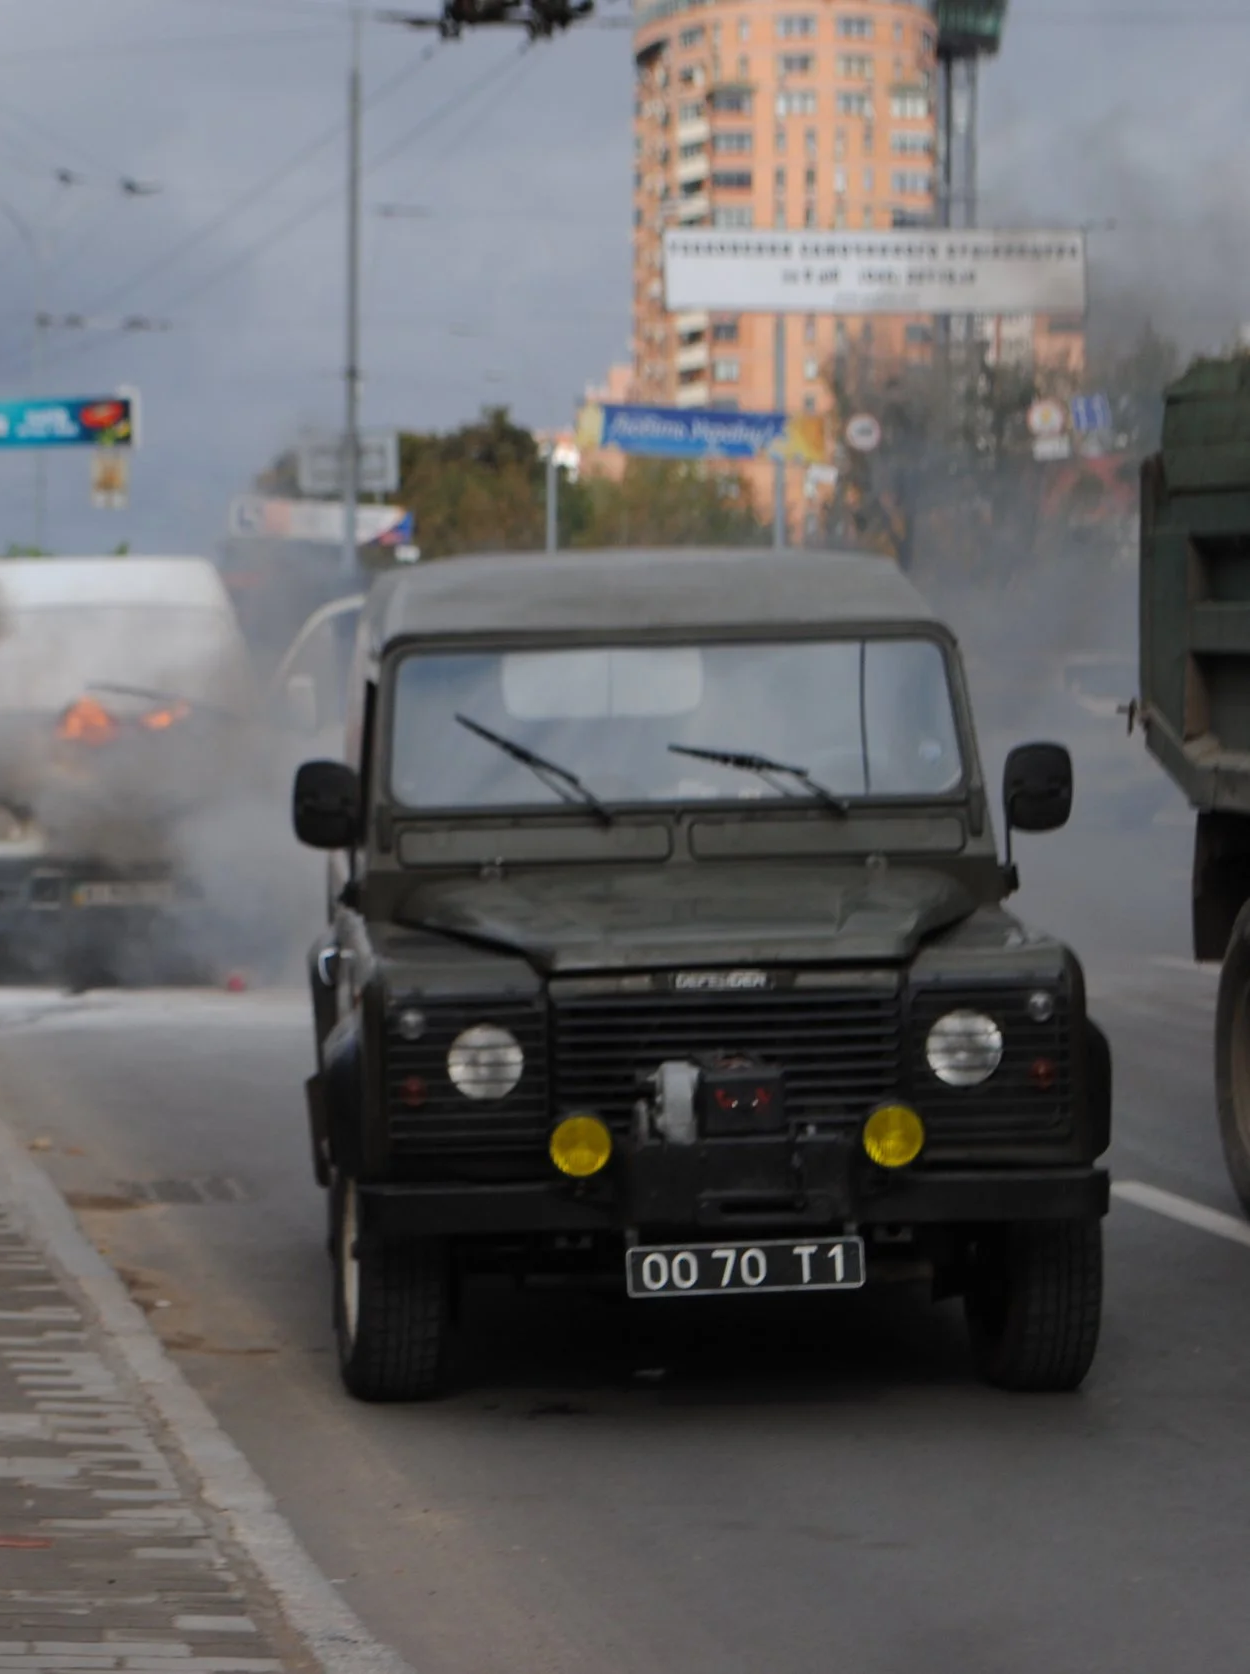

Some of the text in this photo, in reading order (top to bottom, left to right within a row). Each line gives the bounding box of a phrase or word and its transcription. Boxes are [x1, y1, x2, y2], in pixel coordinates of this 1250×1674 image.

[642, 1244, 844, 1290] 00 70 T1
